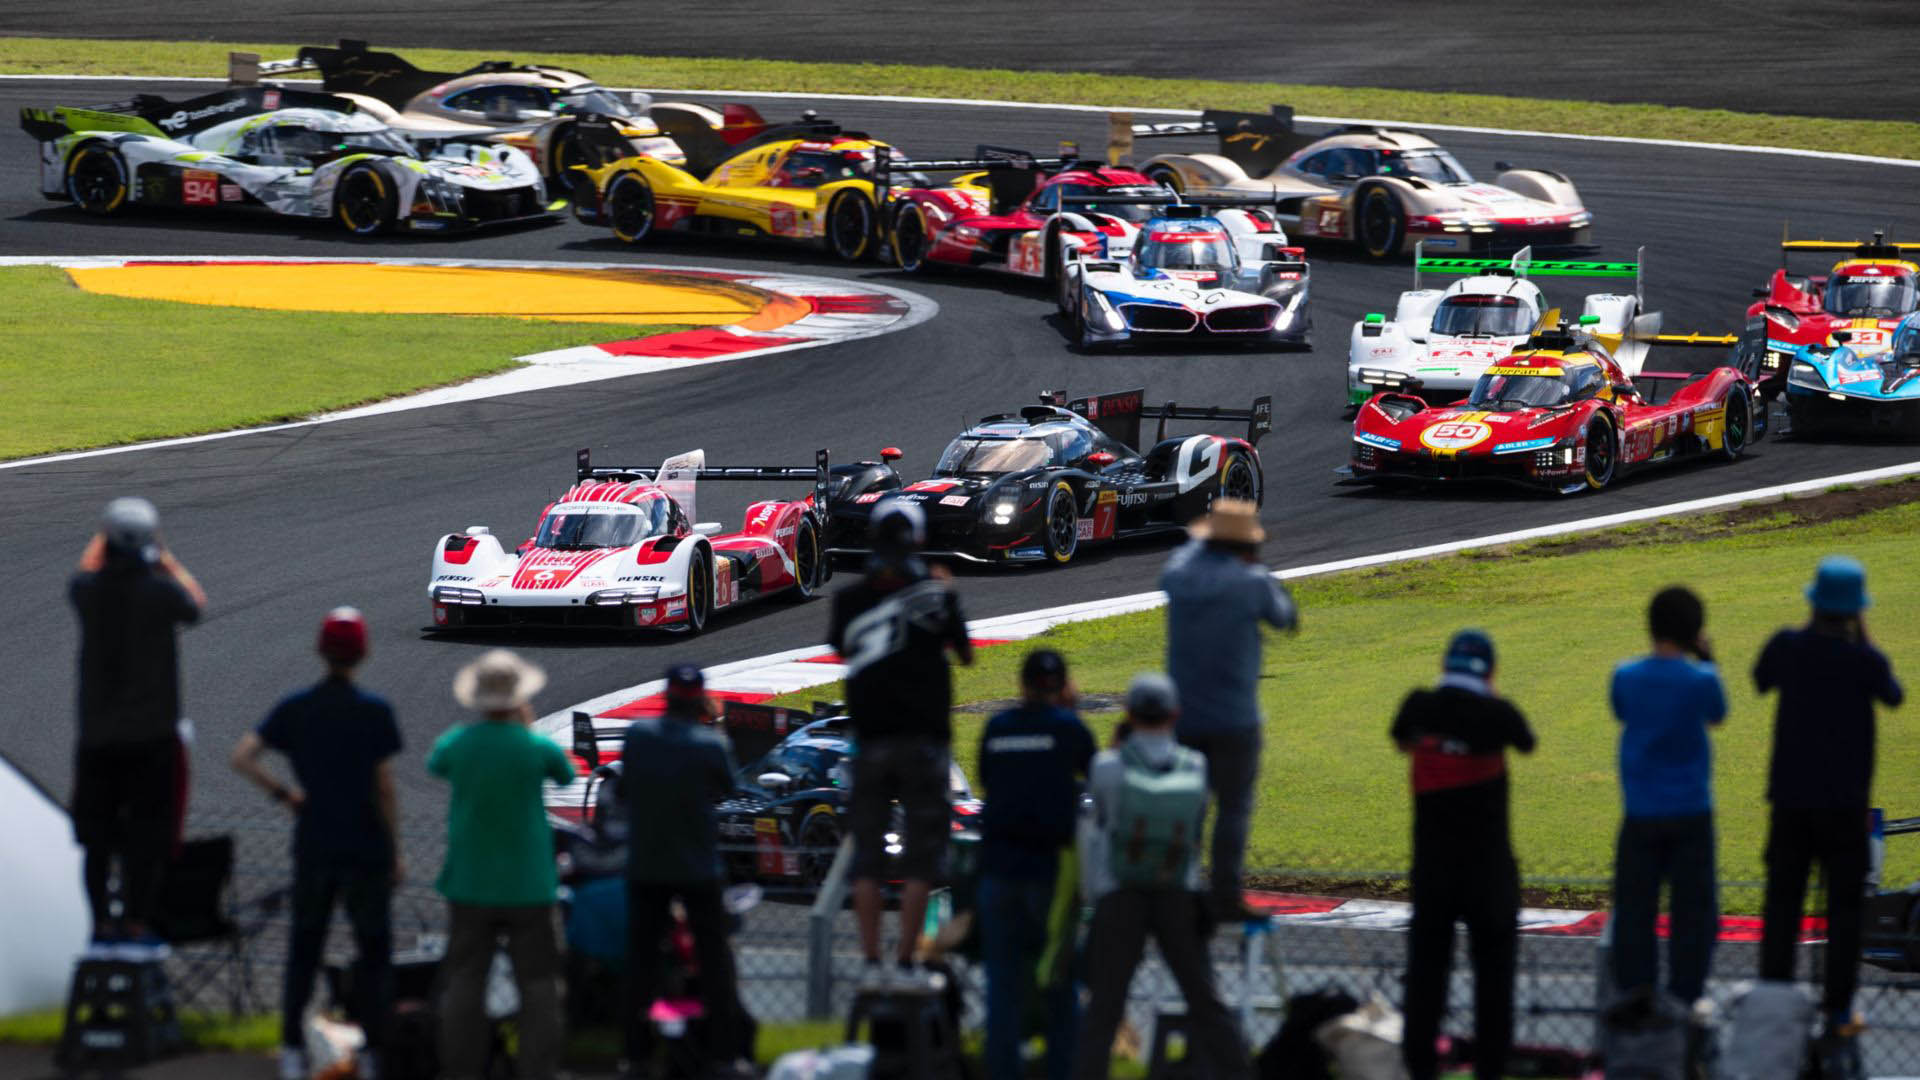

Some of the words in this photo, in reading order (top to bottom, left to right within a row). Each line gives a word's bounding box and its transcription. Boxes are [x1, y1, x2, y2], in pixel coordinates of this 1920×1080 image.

[183, 182, 217, 202] 94
[1256, 403, 1270, 414] JFE
[1435, 424, 1478, 438] 50
[1116, 492, 1148, 508] FUJITSU
[1102, 506, 1113, 536] 7
[534, 570, 556, 580] 6
[617, 575, 665, 583] PENSKE
[721, 572, 728, 601] 6
